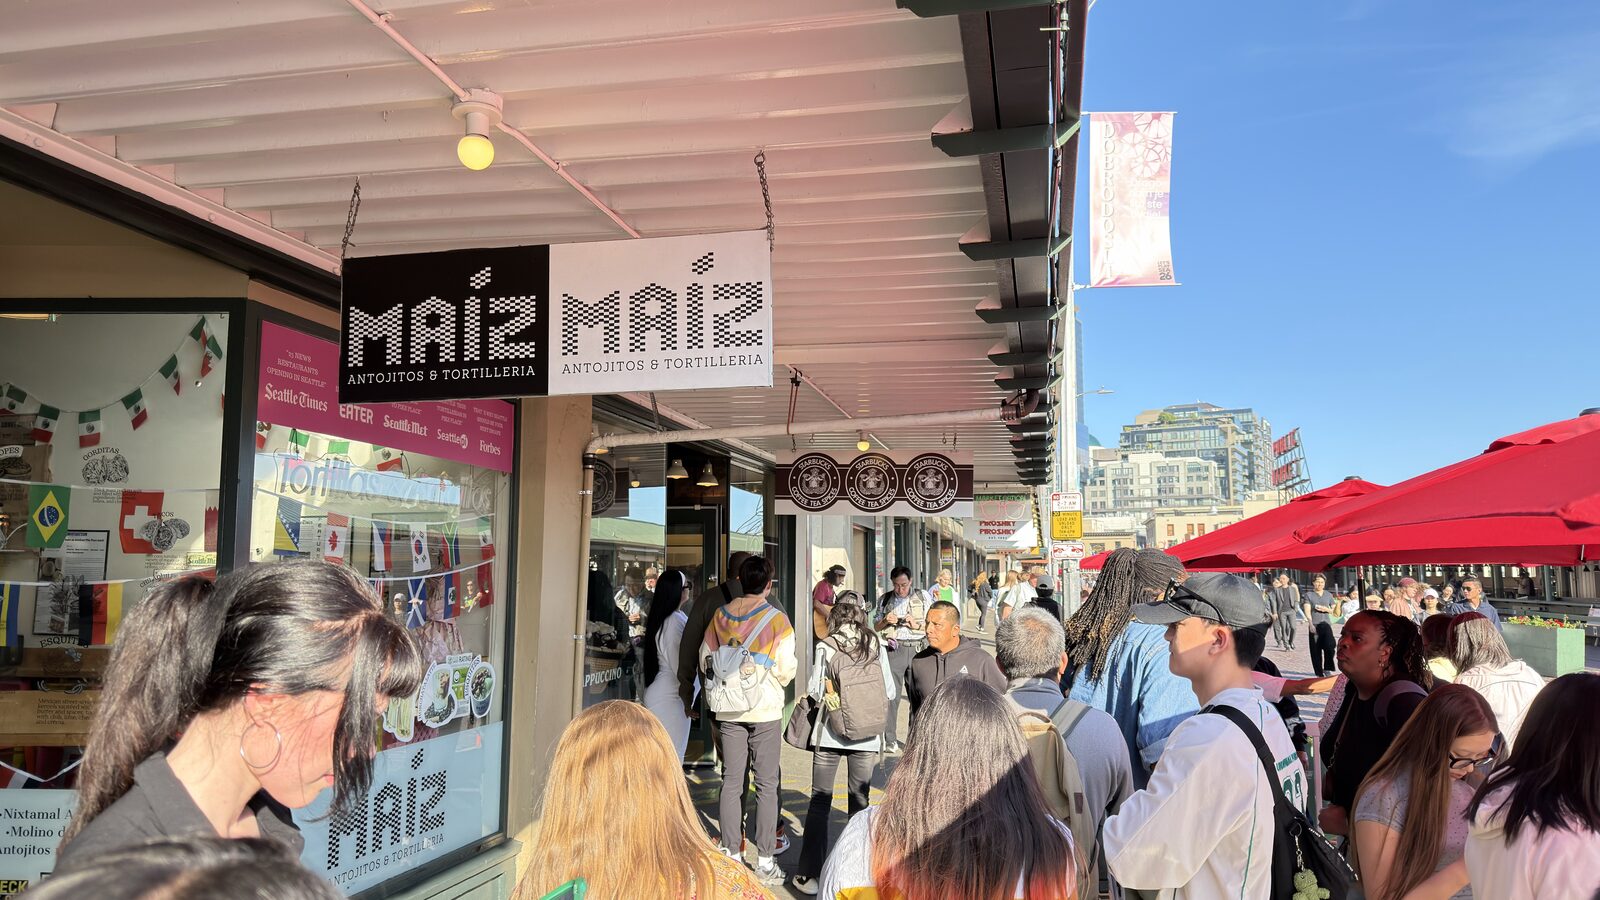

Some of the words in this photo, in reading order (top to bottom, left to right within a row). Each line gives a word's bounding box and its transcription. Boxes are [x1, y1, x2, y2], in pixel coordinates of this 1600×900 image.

[1159, 272, 1172, 281] 26
[562, 252, 763, 356] MAÍZ
[348, 266, 536, 367] MAÍZ
[266, 367, 293, 380] OPENING
[277, 358, 319, 376] RESTAURANTS
[562, 359, 645, 375] ANTOJITOS
[650, 358, 659, 370] &
[664, 354, 764, 369] TORTILLERIA
[347, 370, 424, 386] ANTOJITOS
[429, 369, 438, 381] &
[442, 365, 536, 380] TORTILLERIA
[264, 382, 298, 405] Seattle
[298, 391, 328, 412] Times
[339, 403, 374, 425] EATER
[437, 428, 460, 444] Seattle
[479, 439, 501, 456] Forbes
[798, 458, 832, 471] STARBUCKS
[855, 458, 890, 471] STARBUCKS
[913, 458, 949, 471] STARBUCKS
[791, 486, 808, 505] COFFEE
[821, 487, 838, 504] SPICES
[848, 486, 866, 506] COFFEE
[867, 500, 879, 508] TEA
[879, 487, 896, 505] SPICES
[906, 487, 925, 507] COFFEE
[938, 488, 955, 506] SPICES
[40, 636, 89, 649] ESQUIT
[3, 807, 61, 820] Nixtamal
[327, 747, 447, 870] MAÍZ
[10, 825, 54, 838] Molino
[383, 855, 390, 866] &
[391, 833, 444, 862] TORTILLERIA
